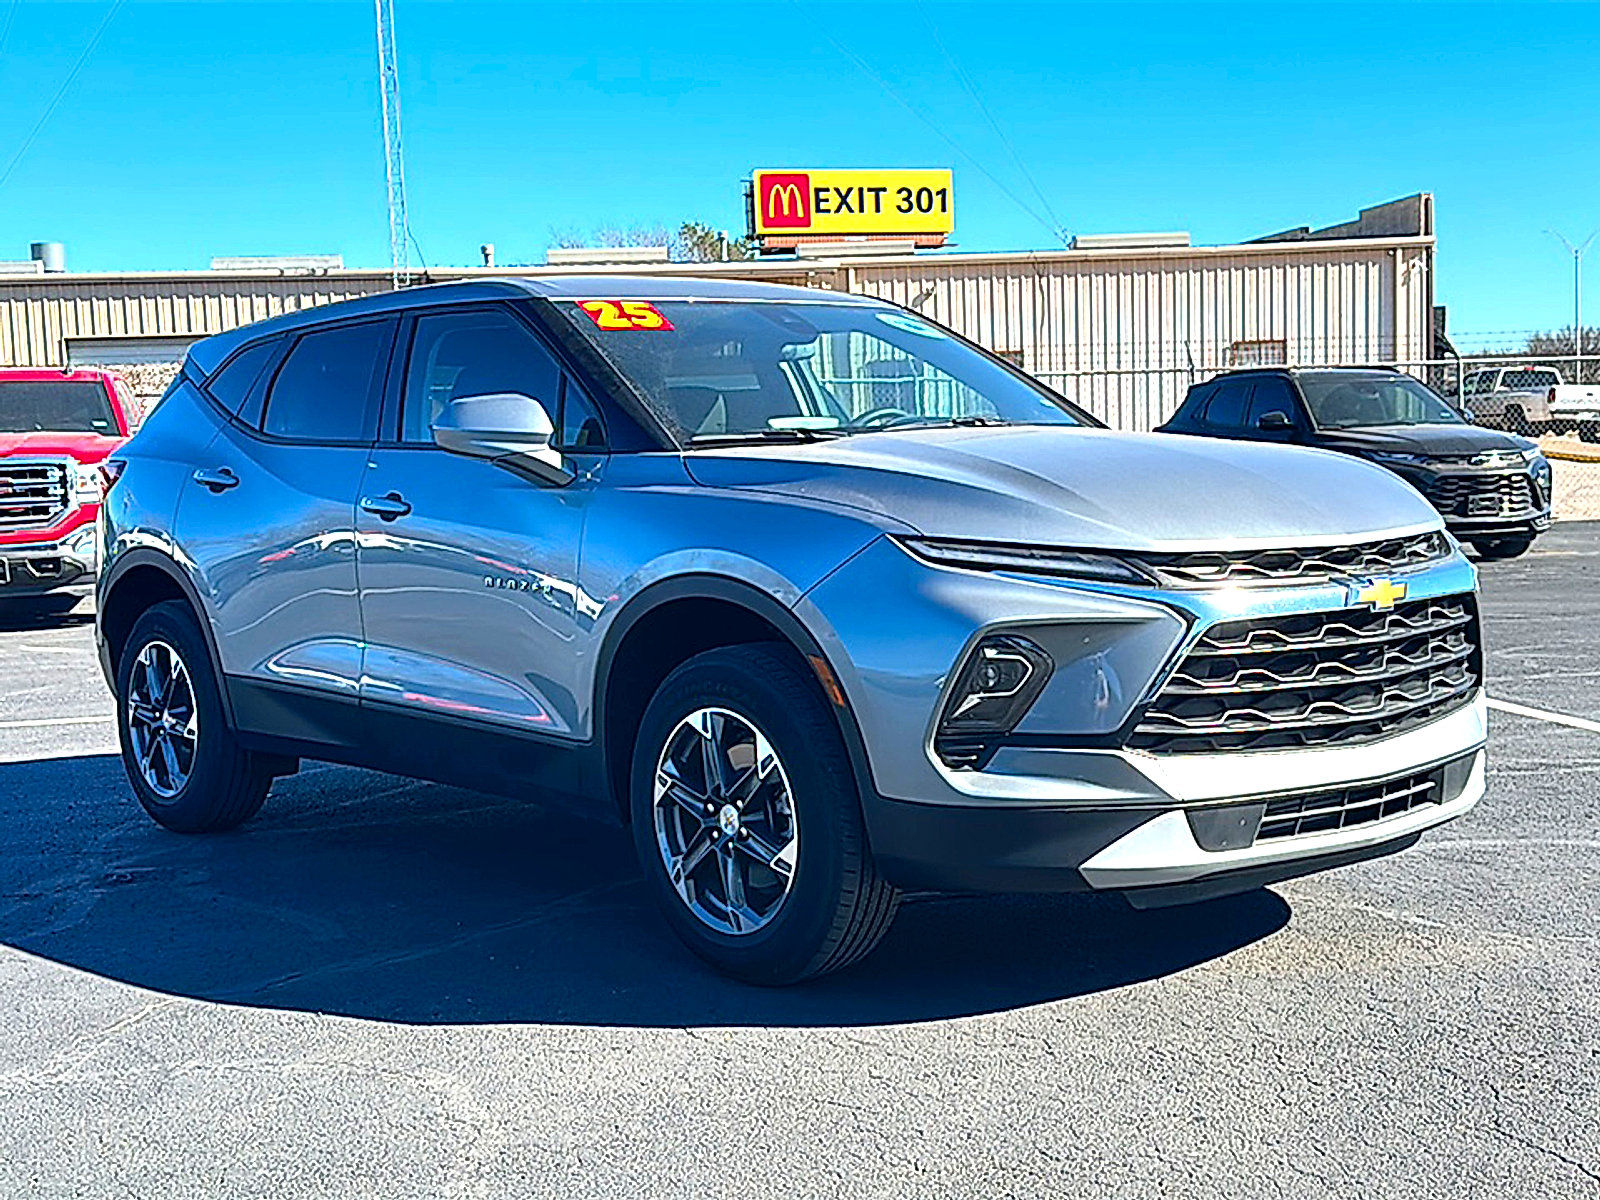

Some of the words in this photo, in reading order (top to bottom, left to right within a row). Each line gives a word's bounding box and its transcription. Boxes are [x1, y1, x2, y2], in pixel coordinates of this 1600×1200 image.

[813, 187, 887, 214] EXIT
[895, 187, 948, 214] 301
[582, 301, 664, 328] 25
